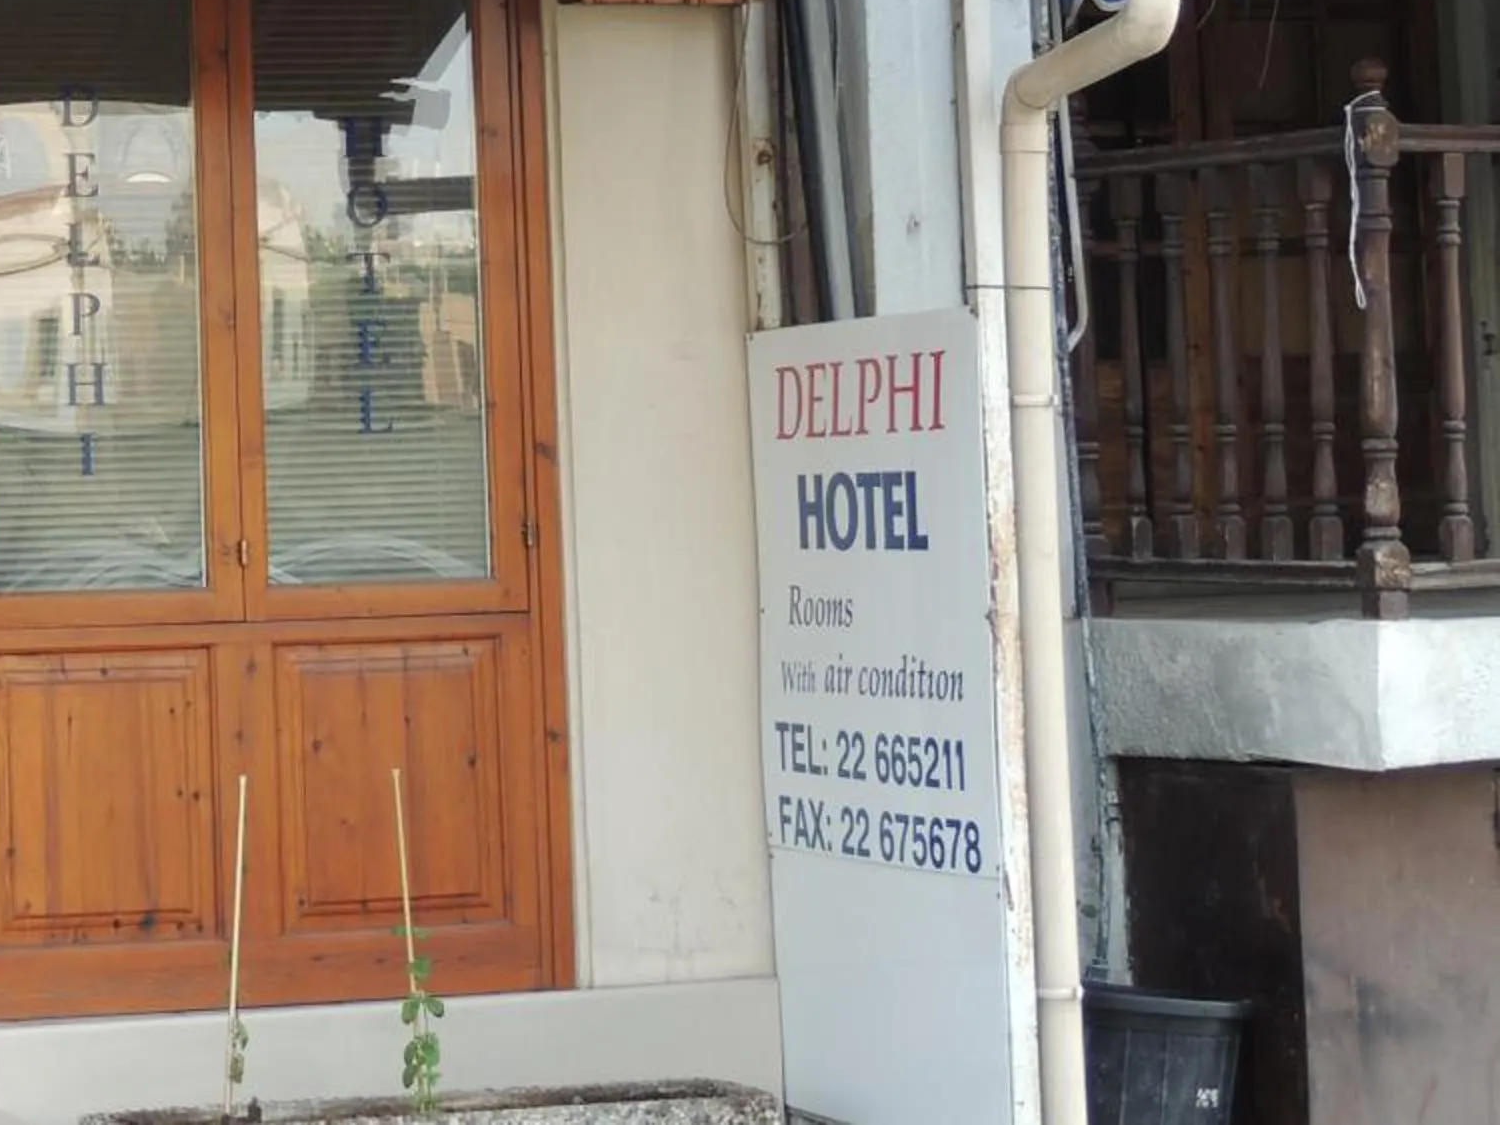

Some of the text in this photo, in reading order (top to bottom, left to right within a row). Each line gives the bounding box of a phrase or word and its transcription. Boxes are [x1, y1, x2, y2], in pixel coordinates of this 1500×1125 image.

[60, 85, 107, 476] DELPHI
[344, 118, 393, 435] HOTEL
[776, 350, 946, 440] DELPHI
[798, 471, 929, 551] HOTEL
[789, 585, 853, 627] Rooms
[781, 653, 964, 702] With air condition
[775, 722, 965, 791] TEL: 22 665211
[779, 795, 982, 873] FAX: 22 675678
